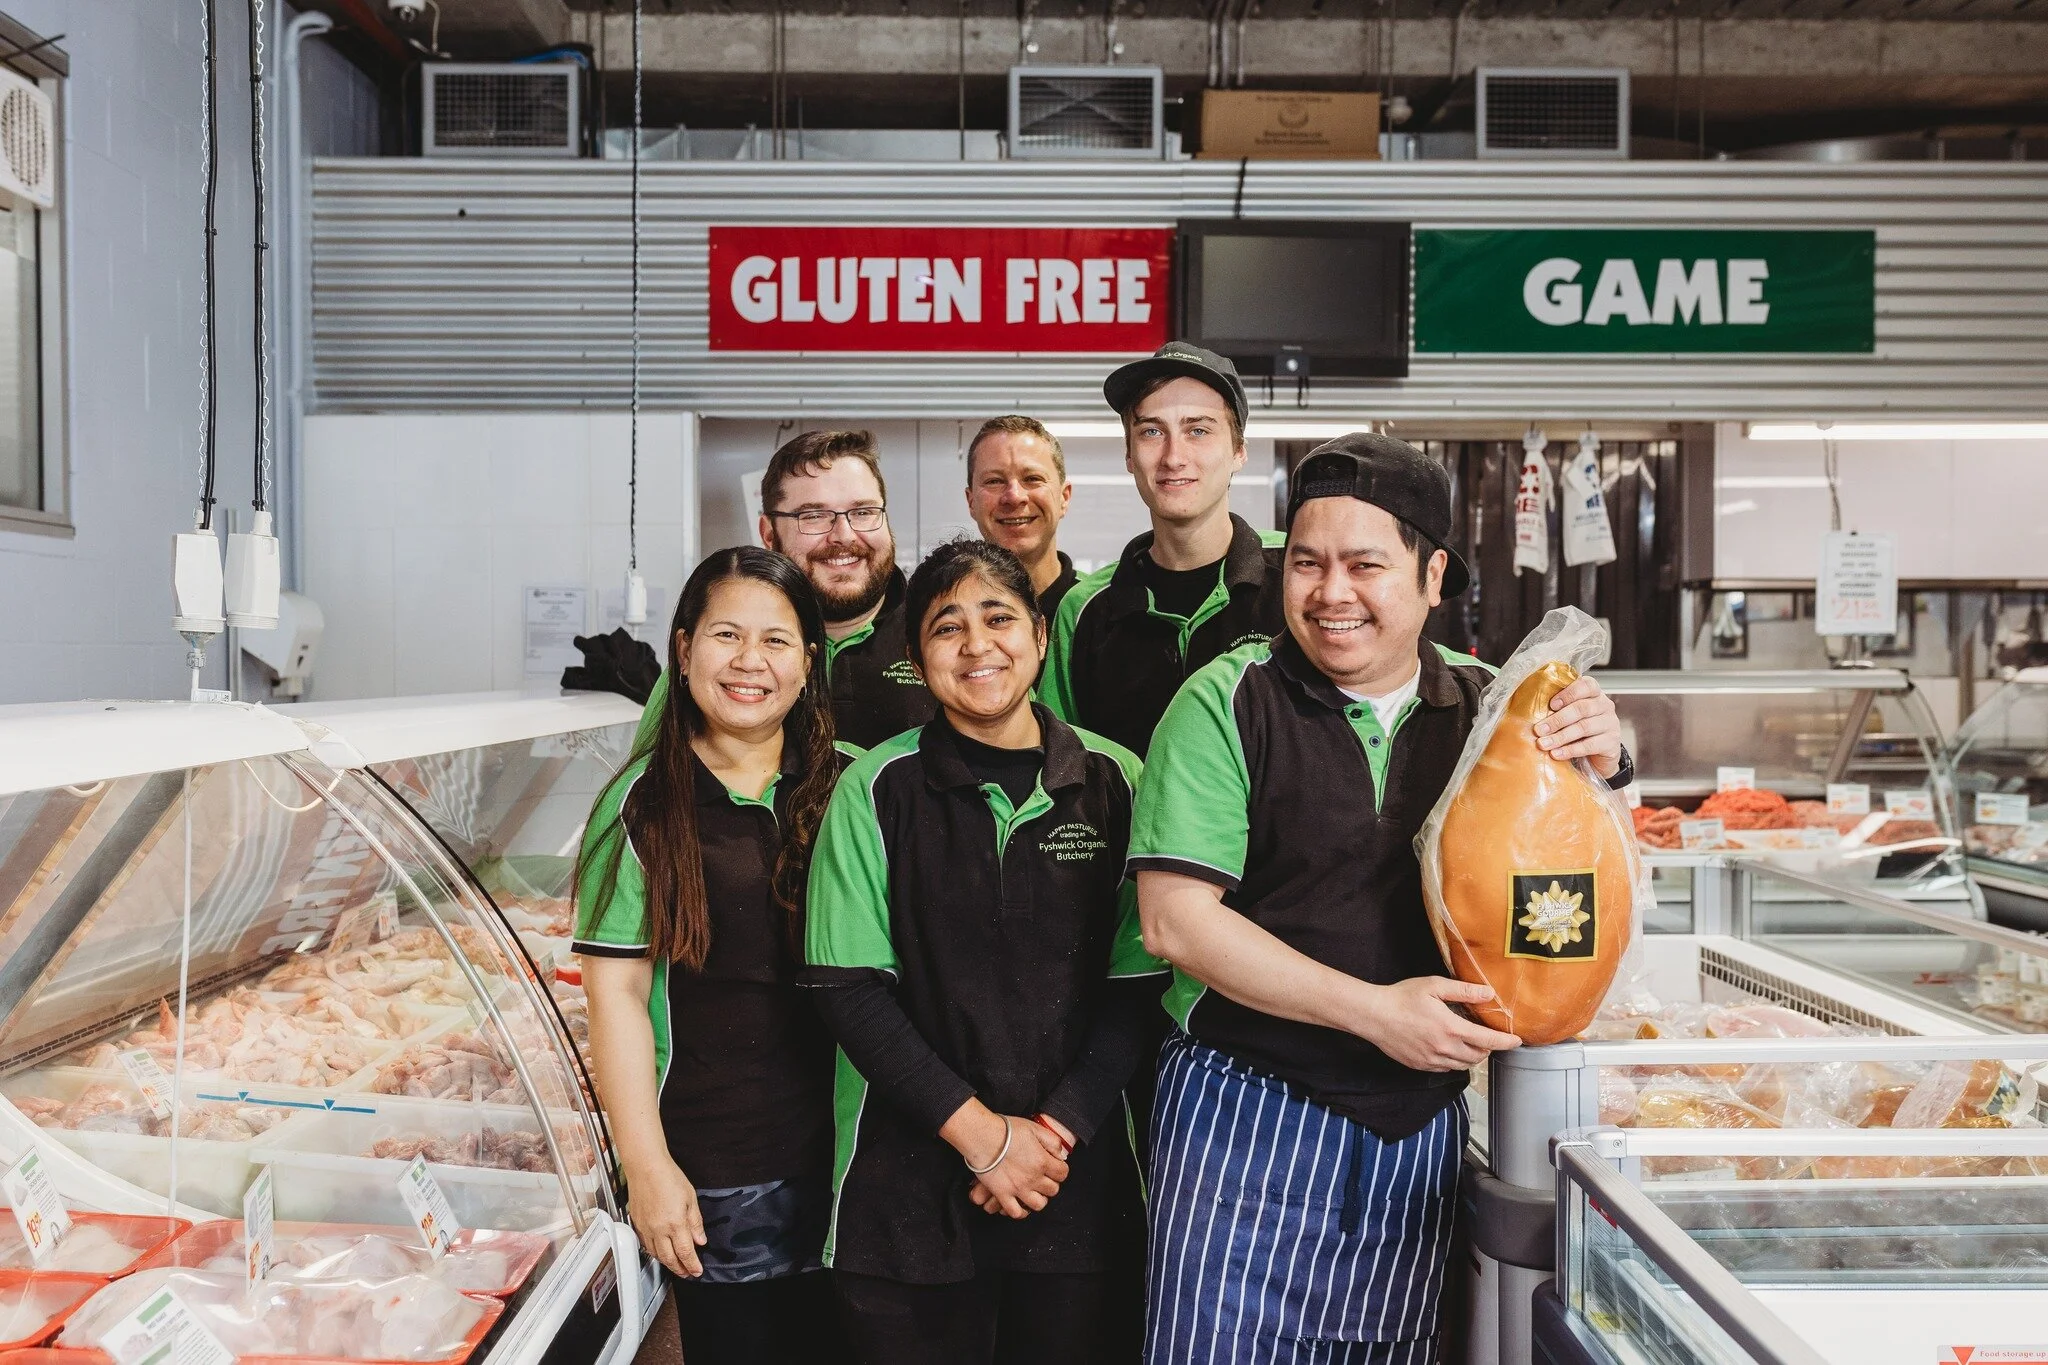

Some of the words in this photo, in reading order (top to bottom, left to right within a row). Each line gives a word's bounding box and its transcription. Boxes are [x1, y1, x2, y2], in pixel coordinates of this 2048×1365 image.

[730, 255, 982, 324] GLUTEN
[1006, 257, 1152, 325] FREE
[1522, 257, 1771, 326] GAME
[1174, 351, 1202, 362] Organic
[1230, 635, 1247, 648] HAPPY
[882, 670, 914, 678] Fyshwick
[1047, 824, 1066, 839] HAPPY
[1067, 823, 1098, 836] PASTURES
[1060, 831, 1079, 839] trading
[1039, 840, 1076, 853] Fyshwick
[1076, 839, 1108, 850] Organic
[1056, 850, 1095, 861] Butchery
